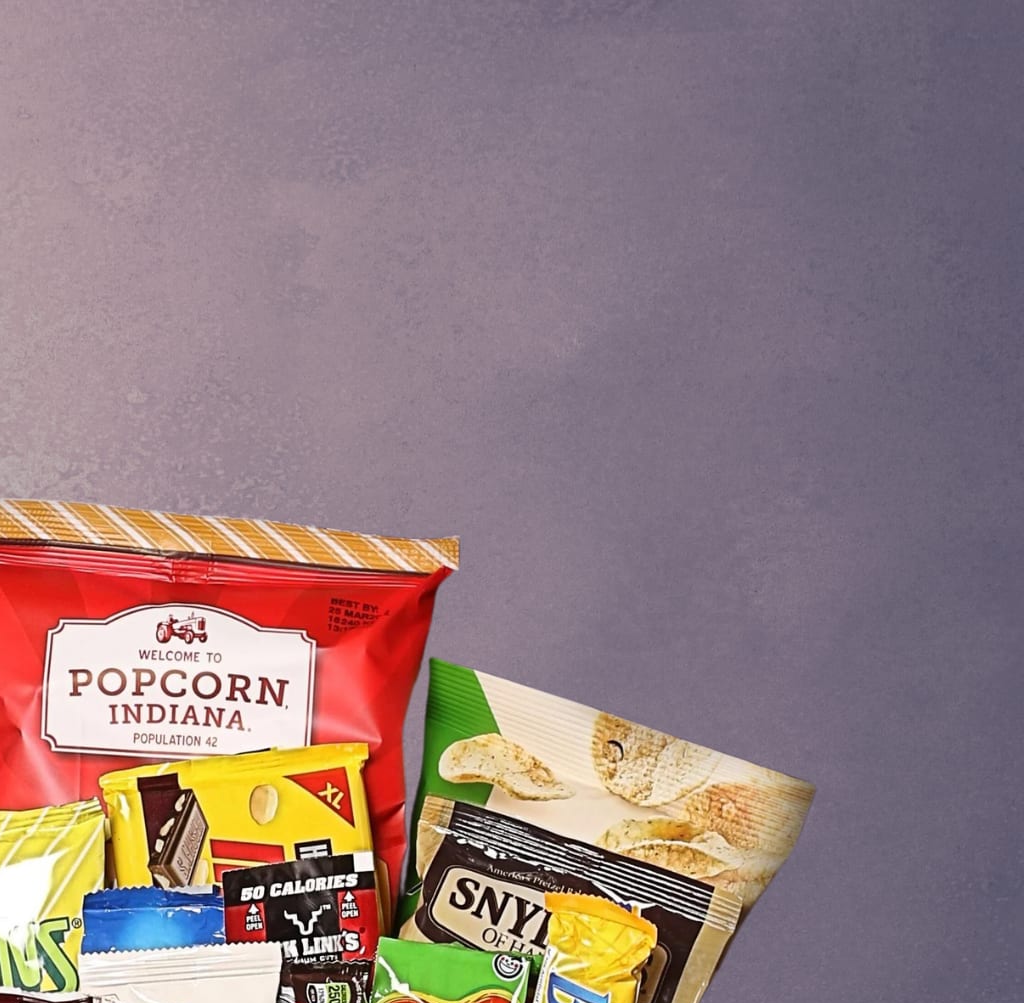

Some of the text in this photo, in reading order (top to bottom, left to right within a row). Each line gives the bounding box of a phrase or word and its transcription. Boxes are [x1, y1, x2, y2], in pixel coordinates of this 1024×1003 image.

[139, 650, 222, 664] WELCOME TO
[133, 733, 218, 748] POPULATION 42
[317, 782, 346, 810] XL
[240, 872, 359, 902] 50 CALORIES
[341, 901, 357, 911] PEEL
[246, 914, 262, 924] PEEL
[341, 909, 359, 919] OPEN
[245, 922, 263, 931] OPEN
[483, 927, 510, 948] OF
